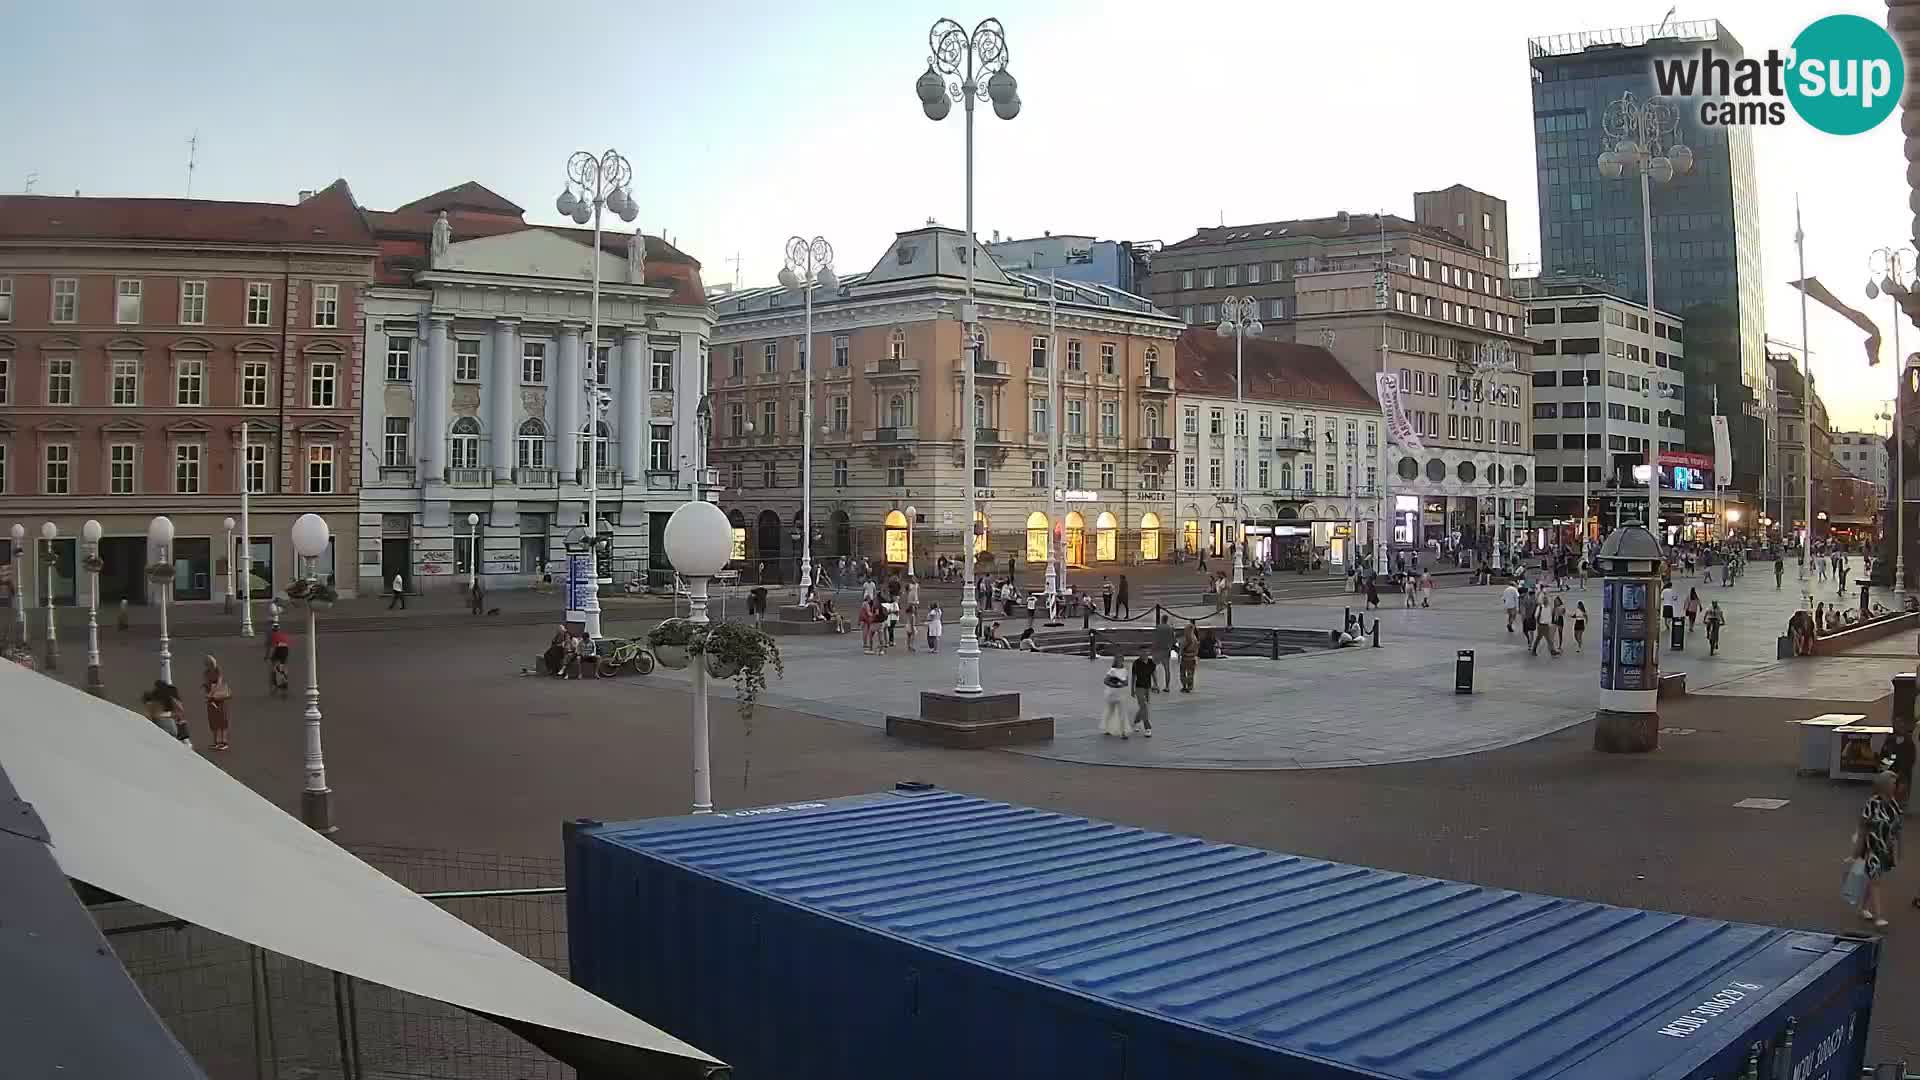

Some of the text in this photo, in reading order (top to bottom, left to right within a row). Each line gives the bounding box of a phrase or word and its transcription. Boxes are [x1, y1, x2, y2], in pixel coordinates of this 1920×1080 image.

[960, 487, 995, 498] SGER
[1136, 491, 1166, 501] SINGER
[1657, 1015, 1708, 1038] MCDU
[1691, 989, 1746, 1017] 300629
